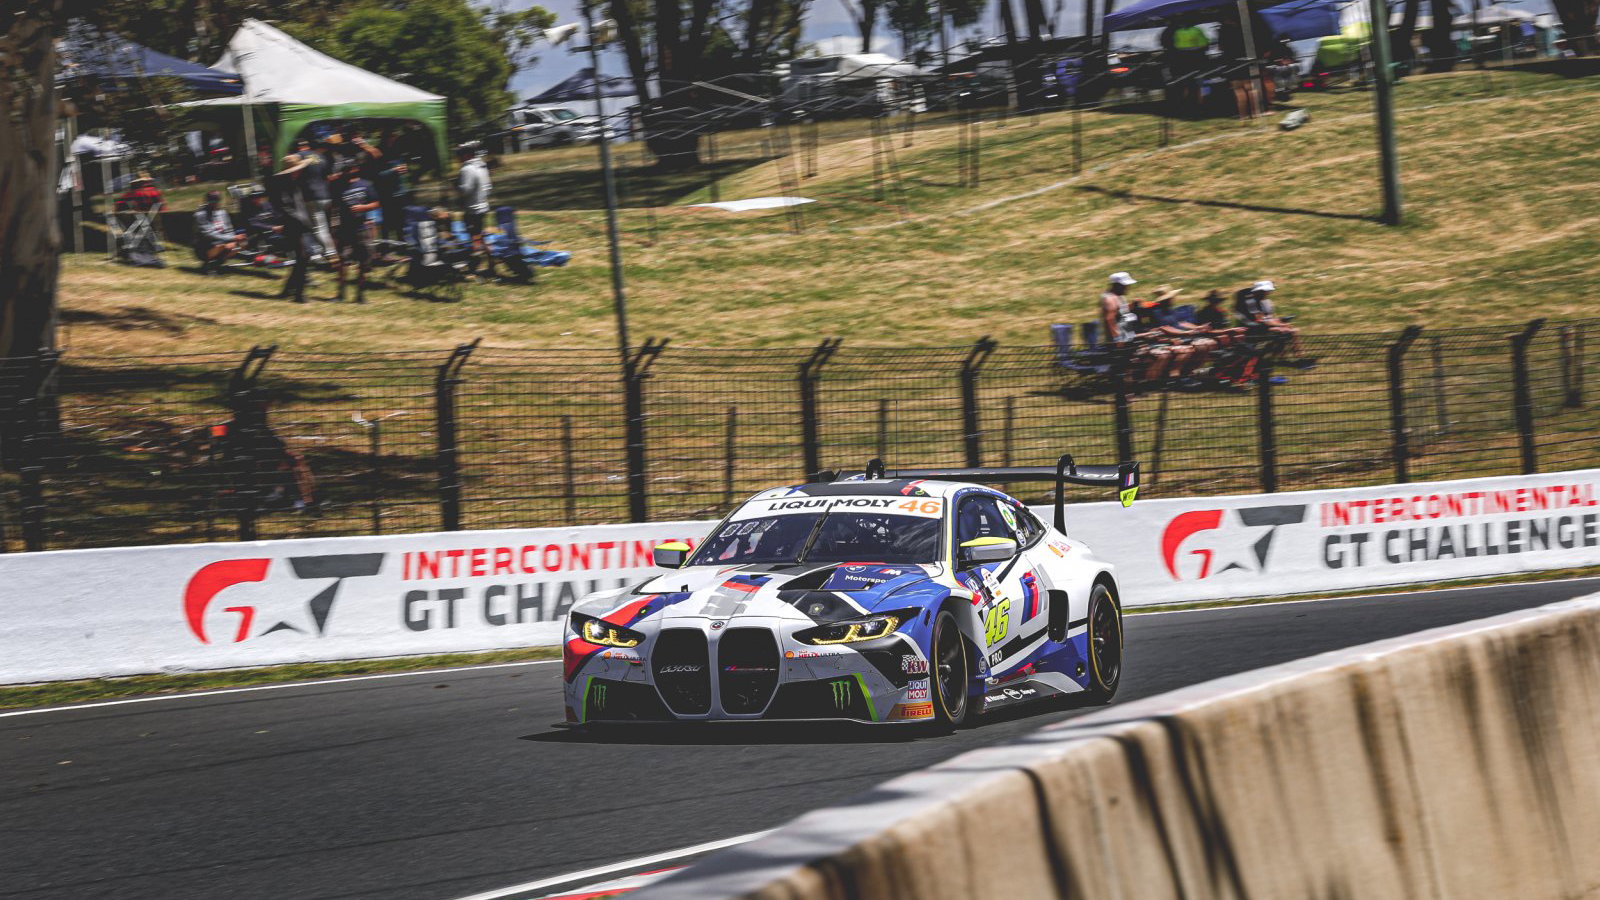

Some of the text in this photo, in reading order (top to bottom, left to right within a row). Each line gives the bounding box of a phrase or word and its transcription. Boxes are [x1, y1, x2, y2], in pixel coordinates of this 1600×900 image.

[768, 499, 941, 514] LIQUI MOLY 46
[1320, 484, 1599, 527] INTERCONTINENTAL
[1324, 513, 1600, 569] GT CHALLENGE
[403, 537, 705, 581] INTERCONTIN
[845, 574, 889, 584] Motorspo
[404, 588, 465, 632] GT
[984, 597, 1011, 648] 46
[991, 649, 1003, 666] PRO
[908, 680, 927, 689] LIQUI
[908, 689, 928, 699] MOLY
